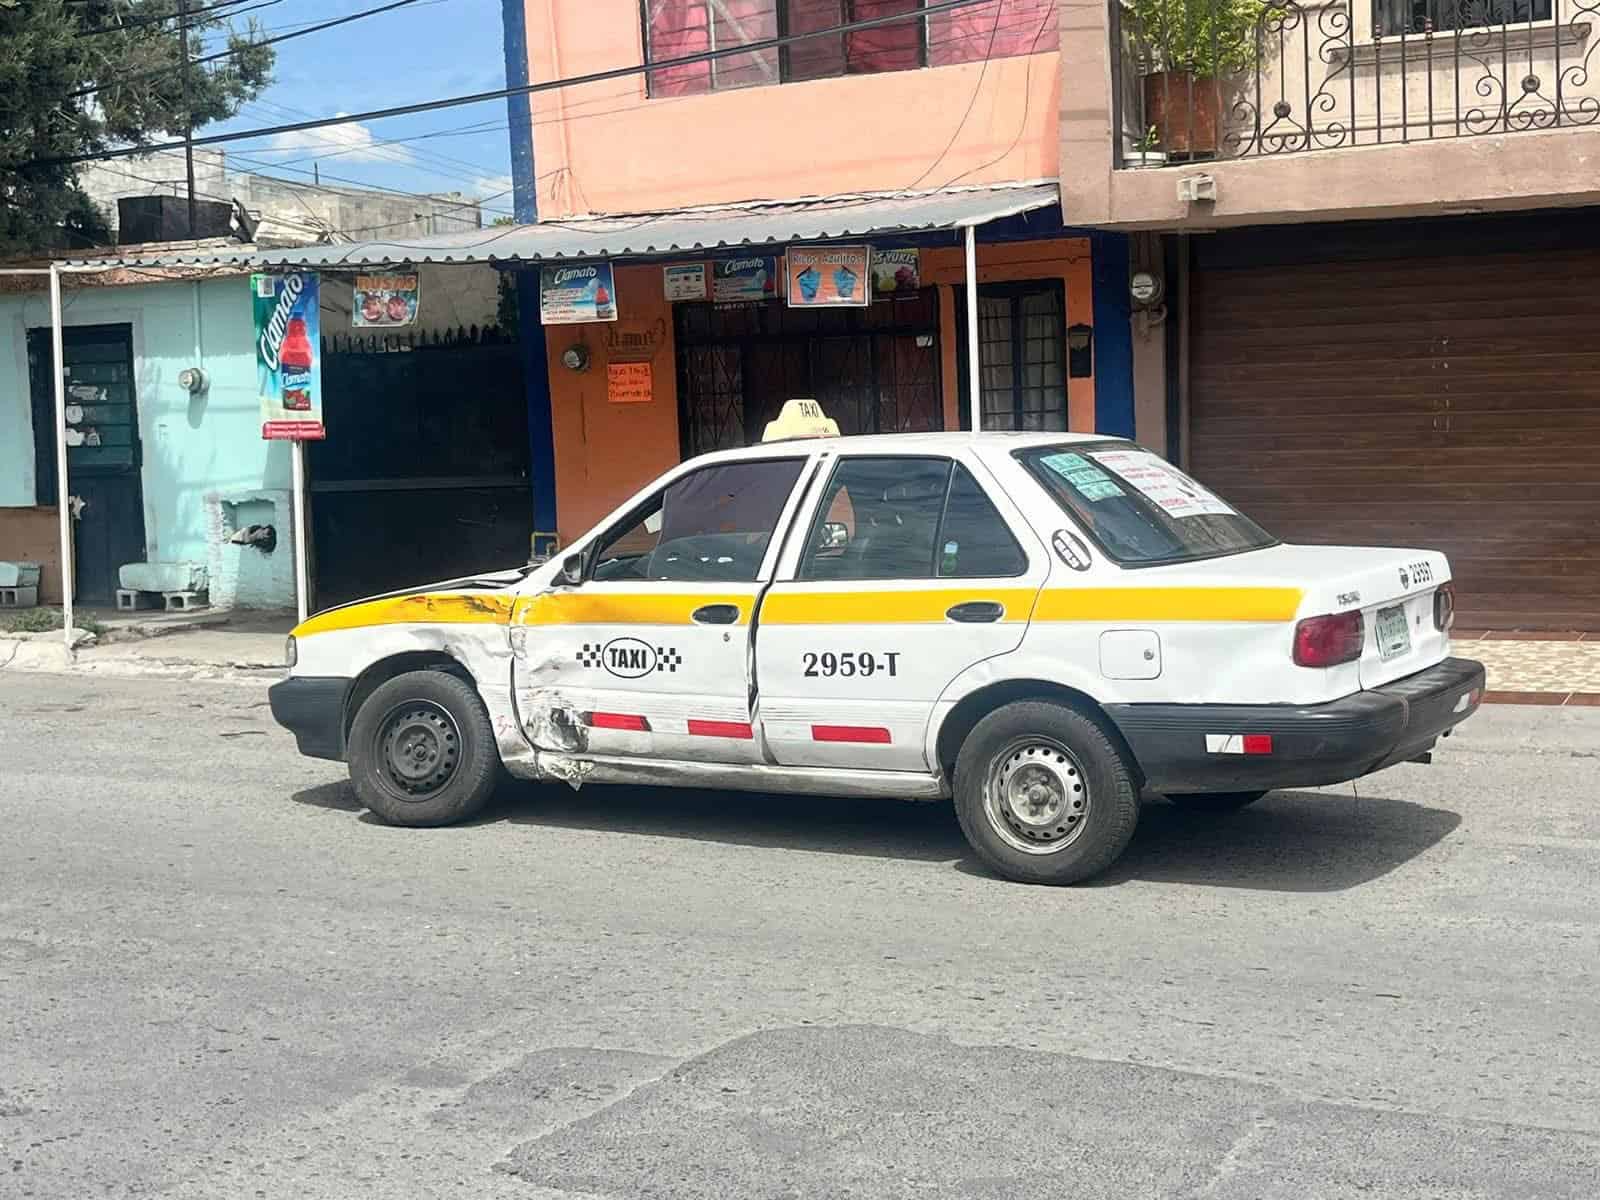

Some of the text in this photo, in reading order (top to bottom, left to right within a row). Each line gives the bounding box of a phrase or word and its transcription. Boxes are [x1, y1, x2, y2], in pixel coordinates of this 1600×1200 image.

[554, 264, 598, 284] Clamato
[724, 256, 765, 276] Clamato
[260, 273, 304, 371] Clamato
[797, 402, 820, 418] TAXI
[609, 647, 647, 669] TAXI
[802, 652, 900, 677] 2959-T
